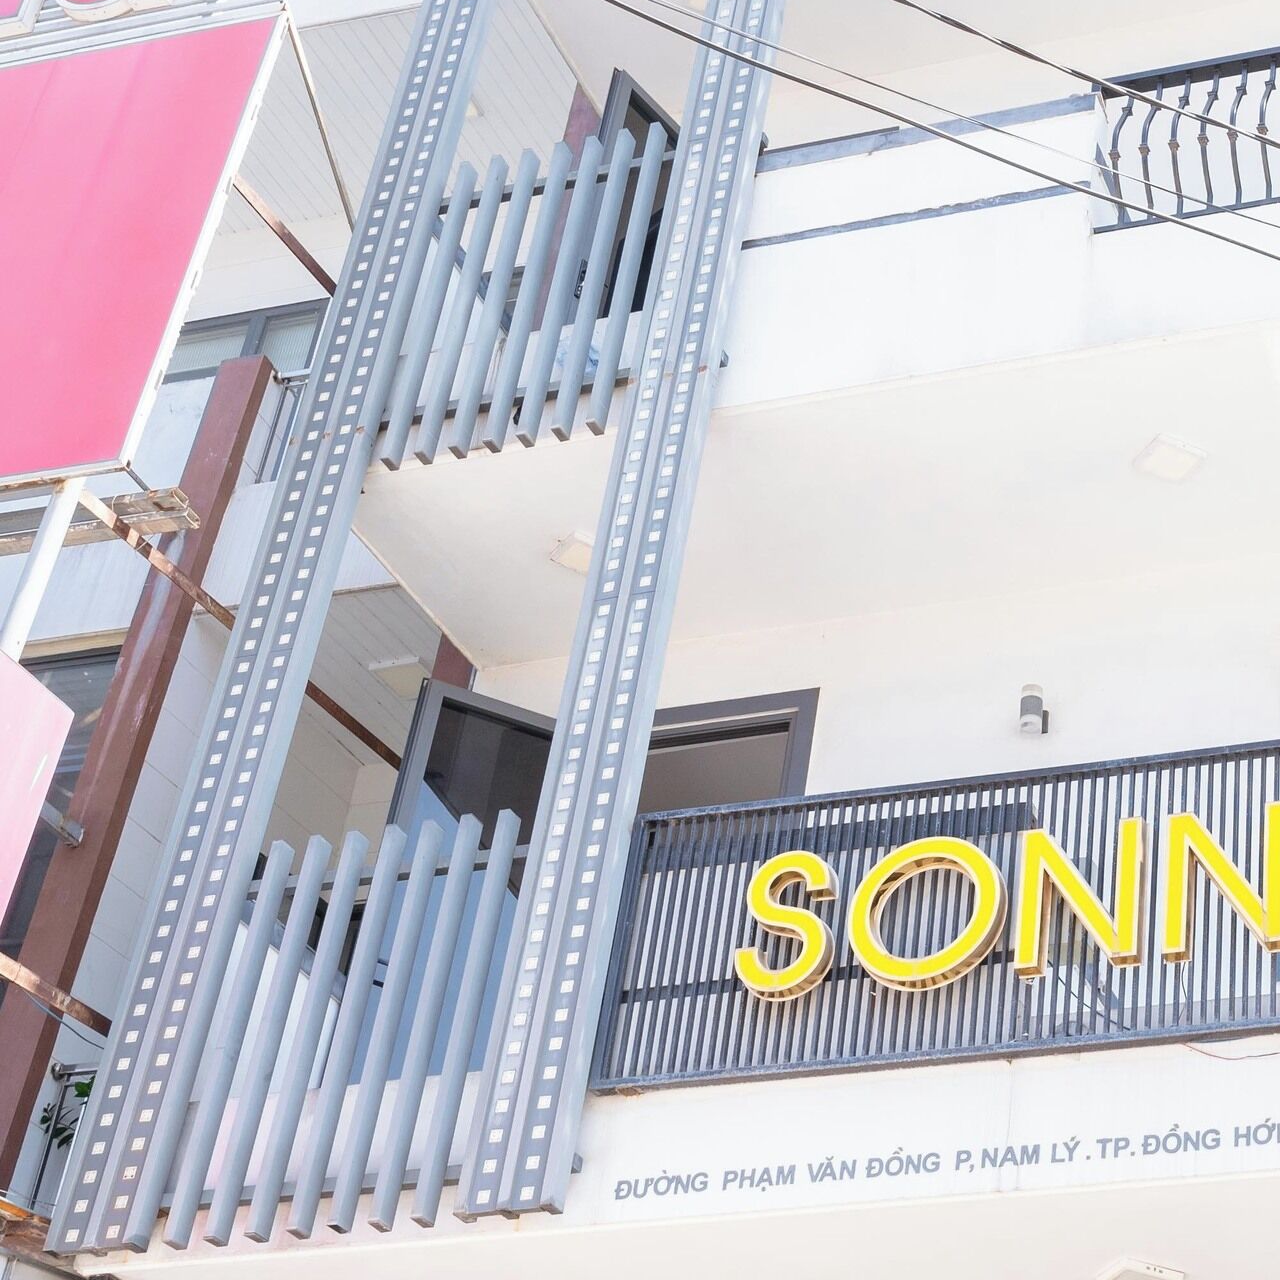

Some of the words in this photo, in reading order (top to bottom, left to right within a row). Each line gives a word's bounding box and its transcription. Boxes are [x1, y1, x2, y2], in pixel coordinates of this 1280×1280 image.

[613, 1169, 709, 1201] ĐƯỜNG
[722, 1164, 796, 1192] PHẠM
[807, 1156, 857, 1183] VĂN
[865, 1146, 941, 1178] ĐỒNG
